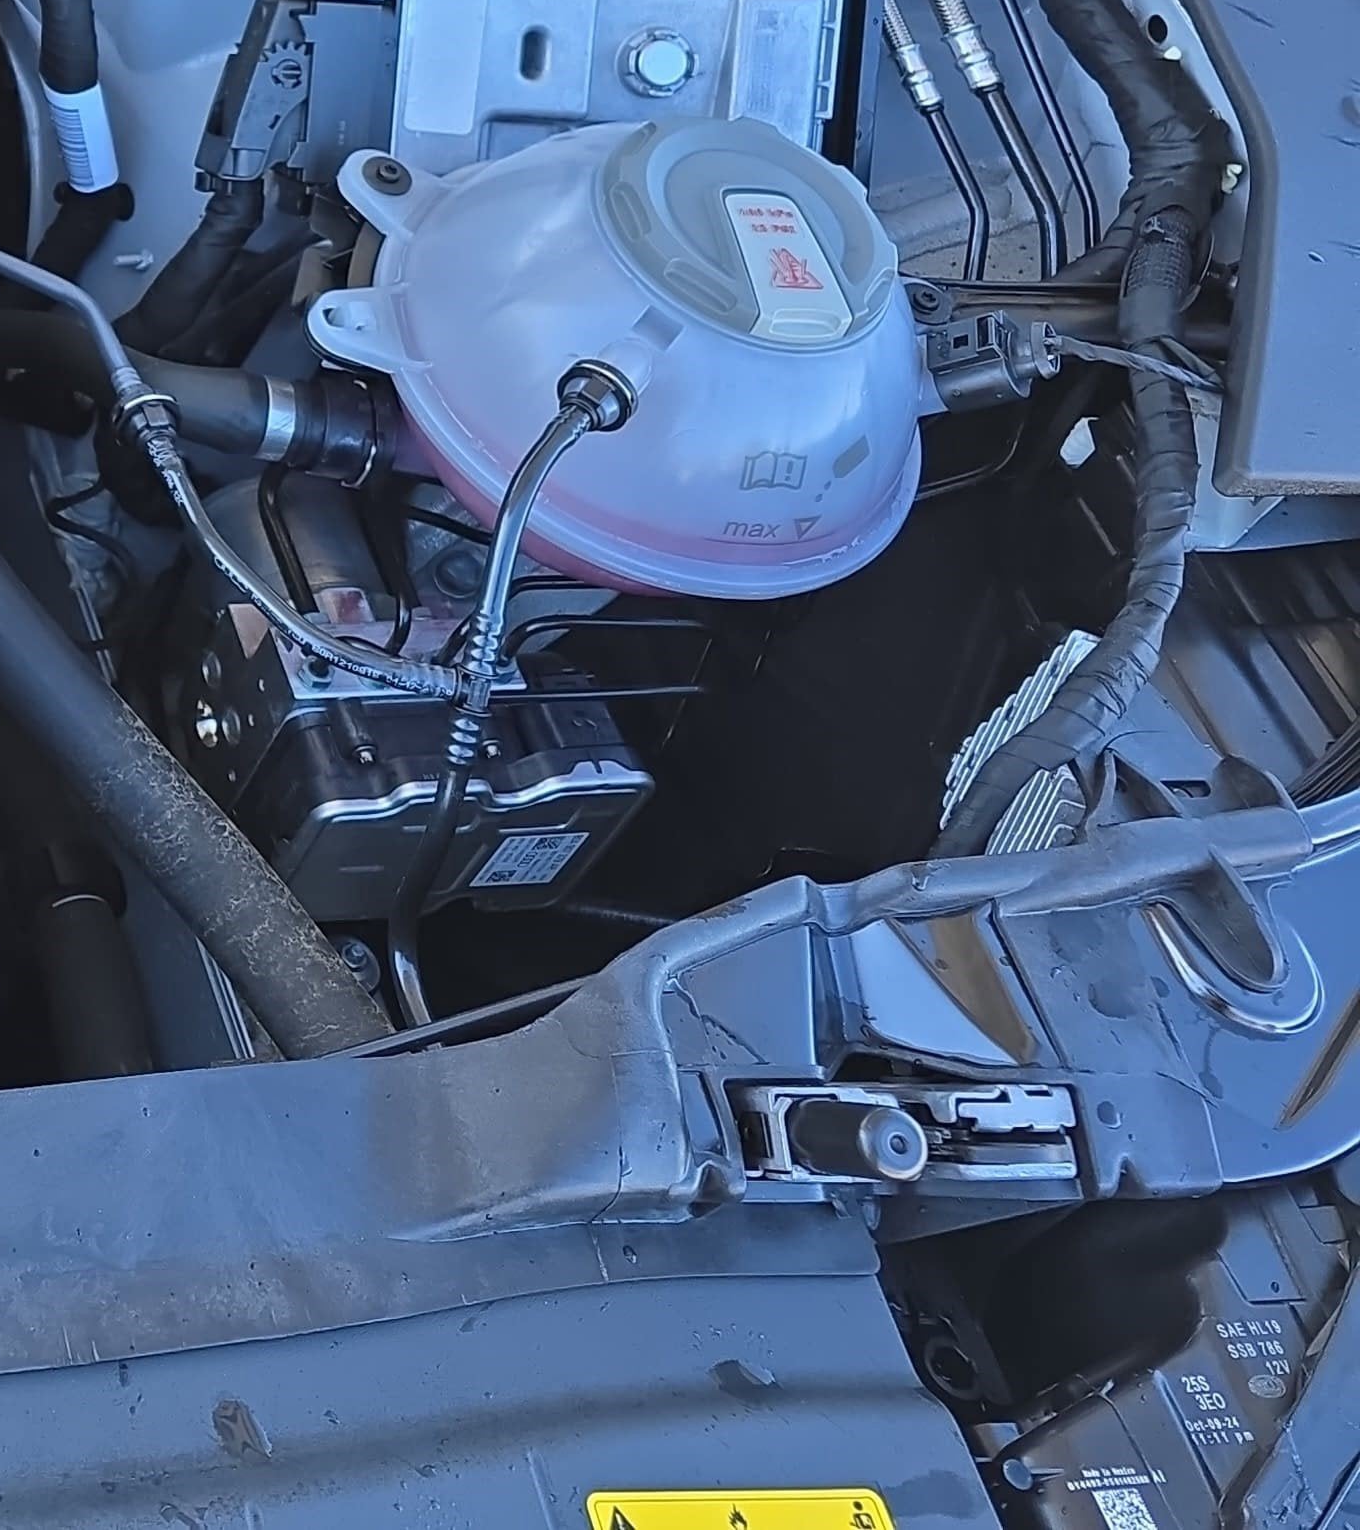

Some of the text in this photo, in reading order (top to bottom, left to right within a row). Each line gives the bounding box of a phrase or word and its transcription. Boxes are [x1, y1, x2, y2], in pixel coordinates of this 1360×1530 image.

[721, 516, 783, 541] max
[1216, 1319, 1282, 1338] SAE HL19
[1226, 1340, 1285, 1359] SSB 786
[1265, 1359, 1291, 1375] 12V
[1234, 1431, 1254, 1444] pm
